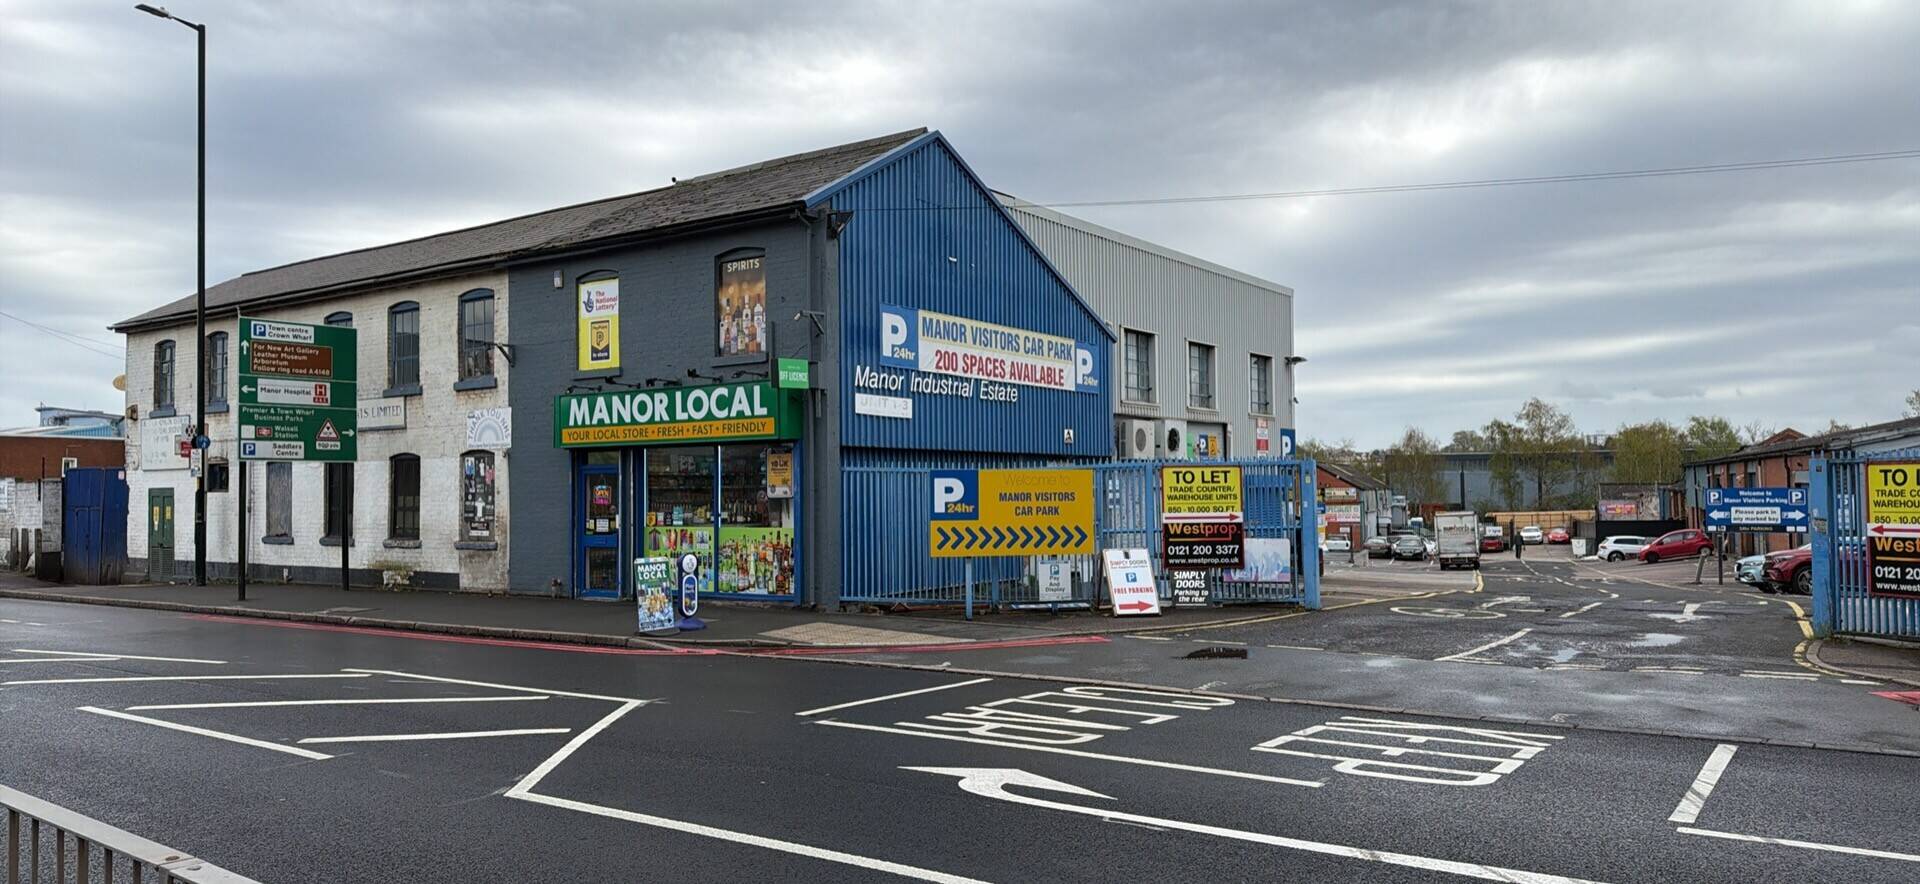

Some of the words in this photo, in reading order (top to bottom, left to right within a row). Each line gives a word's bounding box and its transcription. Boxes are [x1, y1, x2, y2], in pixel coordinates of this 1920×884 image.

[727, 258, 760, 273] SPIRITS
[595, 296, 618, 304] National
[595, 303, 616, 311] Lottery
[256, 325, 264, 335] P
[268, 324, 286, 332] Town
[288, 326, 308, 334] centre
[882, 312, 907, 357] P
[922, 316, 968, 344] MANOR
[970, 326, 1020, 353] VISITORS
[1024, 336, 1044, 357] CAR
[1048, 340, 1073, 362] PARK
[296, 347, 320, 356] Gallery
[893, 348, 916, 360] 24hr
[254, 358, 288, 366] Arboretum
[1076, 348, 1093, 384] P
[278, 366, 291, 374] ring
[934, 350, 958, 372] 200
[962, 356, 1006, 380] SPACES
[1008, 362, 1064, 386] AVAILABLE
[854, 365, 904, 391] Manor
[910, 372, 974, 398] Industrial
[980, 380, 1018, 402] Estate
[1083, 375, 1098, 386] 24hr
[284, 388, 312, 397] Hospital
[316, 385, 324, 396] H
[568, 390, 670, 426] MANOR
[675, 385, 768, 421] LOCAL
[372, 406, 401, 418] LIMITED
[486, 408, 502, 420] YOU
[568, 430, 590, 441] YOUR
[593, 428, 620, 440] LOCAL
[622, 427, 649, 439] STORE
[656, 425, 684, 438] FRESH
[692, 424, 714, 436] FAST
[722, 422, 766, 434] FRIENDLY
[246, 444, 254, 454] P
[1004, 475, 1057, 486] Welcome
[1058, 475, 1072, 486] to
[1172, 470, 1195, 484] TO
[1201, 470, 1230, 484] LET
[1879, 469, 1908, 486] TO
[1196, 485, 1236, 493] COUNTER/
[1875, 490, 1906, 498] TRADE
[934, 478, 964, 513] P
[999, 492, 1032, 502] MANOR
[1035, 492, 1076, 502] VISITORS
[1216, 493, 1238, 501] UNITS
[1710, 492, 1719, 503] P
[1792, 492, 1802, 503] P
[948, 502, 975, 513] 24hr
[1872, 500, 1920, 508] WAREHOU
[1014, 506, 1033, 516] CAR
[1036, 506, 1060, 516] PARK
[1874, 516, 1891, 524] 850
[1168, 545, 1190, 555] 0121
[1192, 545, 1212, 555] 200
[1216, 544, 1239, 554] 3377
[1875, 537, 1920, 552] West
[638, 563, 666, 572] MANOR
[1052, 566, 1058, 575] P
[1875, 566, 1901, 579] 0121
[1905, 568, 1920, 580] 20
[638, 572, 667, 580] LOCAL
[1128, 573, 1135, 582] P
[1174, 571, 1206, 580] SIMPLY
[1176, 580, 1205, 588] DOORS
[1876, 583, 1920, 592] www.west
[893, 686, 1236, 745] CLEAR
[1249, 716, 1566, 786] KEEP
